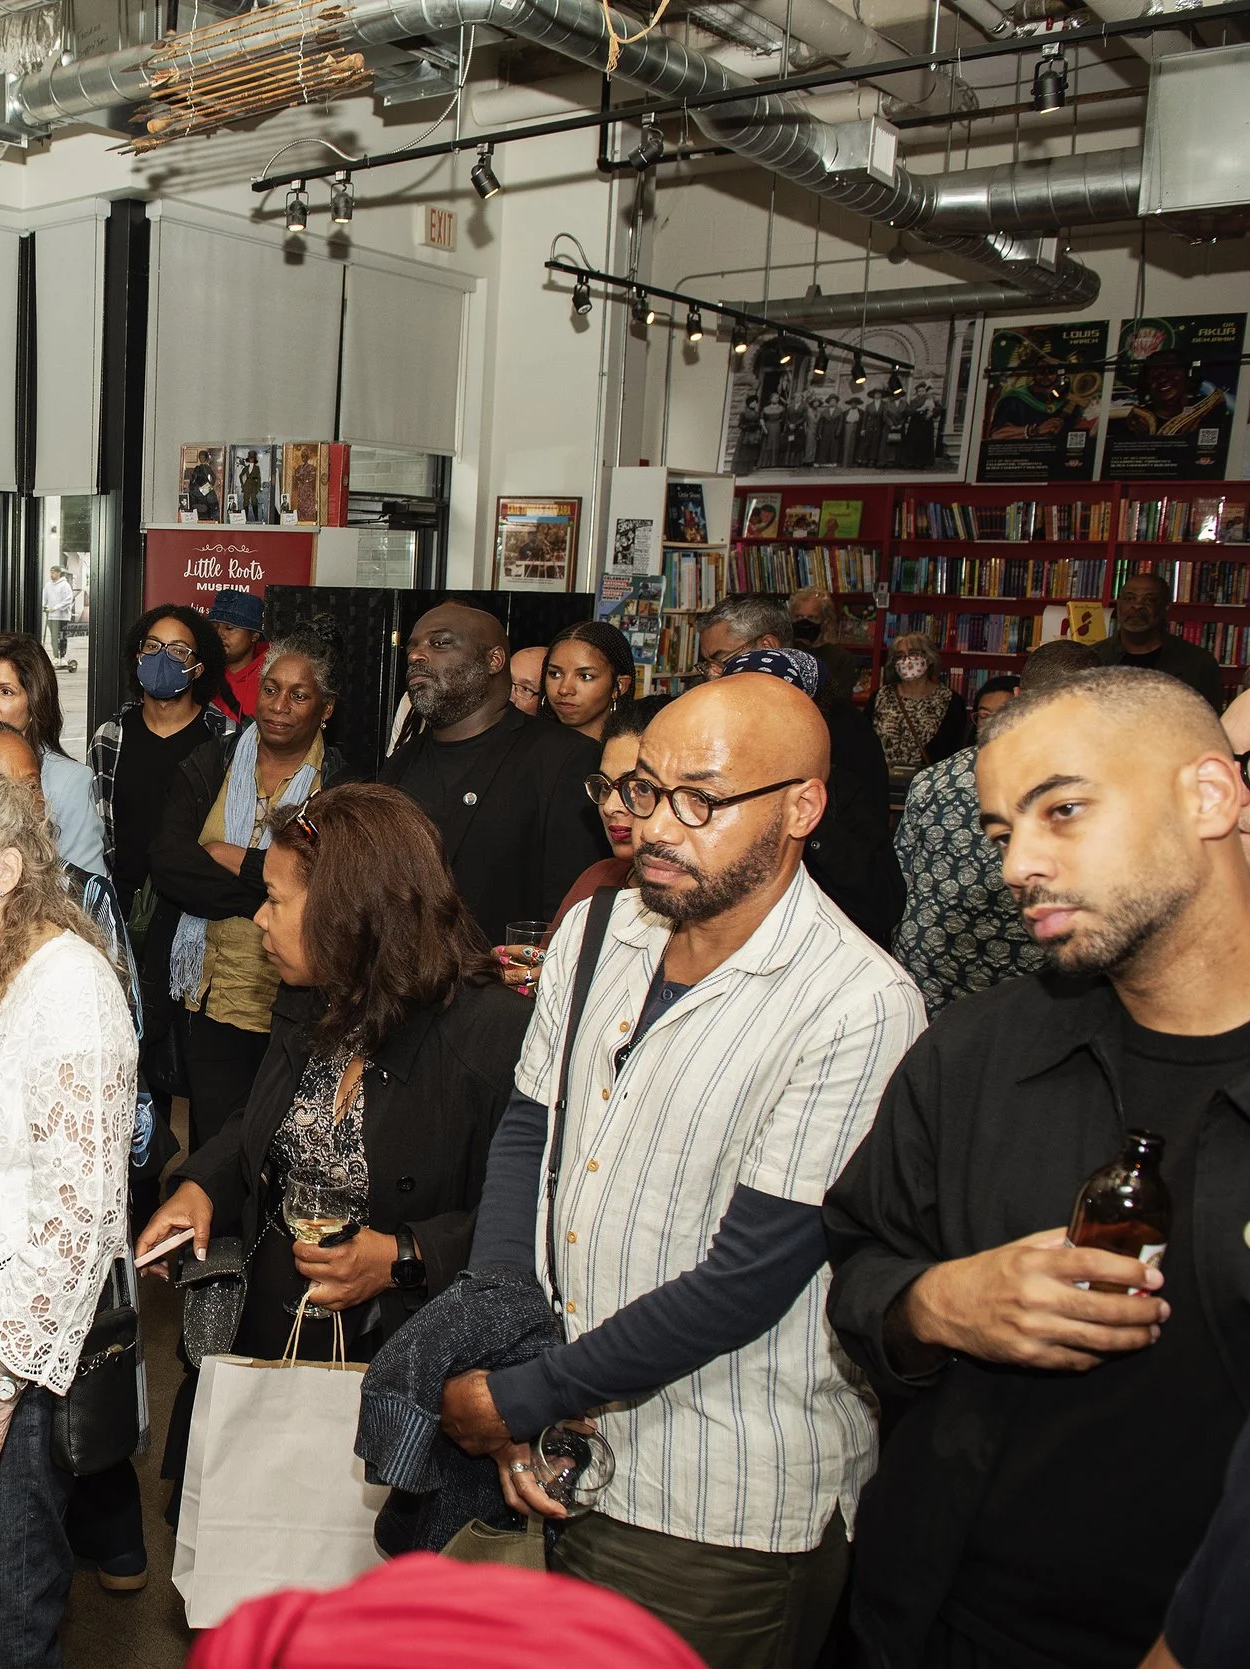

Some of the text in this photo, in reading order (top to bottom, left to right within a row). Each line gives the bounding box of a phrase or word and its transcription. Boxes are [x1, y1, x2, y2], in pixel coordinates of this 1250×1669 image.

[430, 207, 454, 247] EXIT
[1062, 329, 1101, 339] LOUIS
[183, 556, 266, 581] Little Roots
[196, 582, 250, 593] MUSEUM
